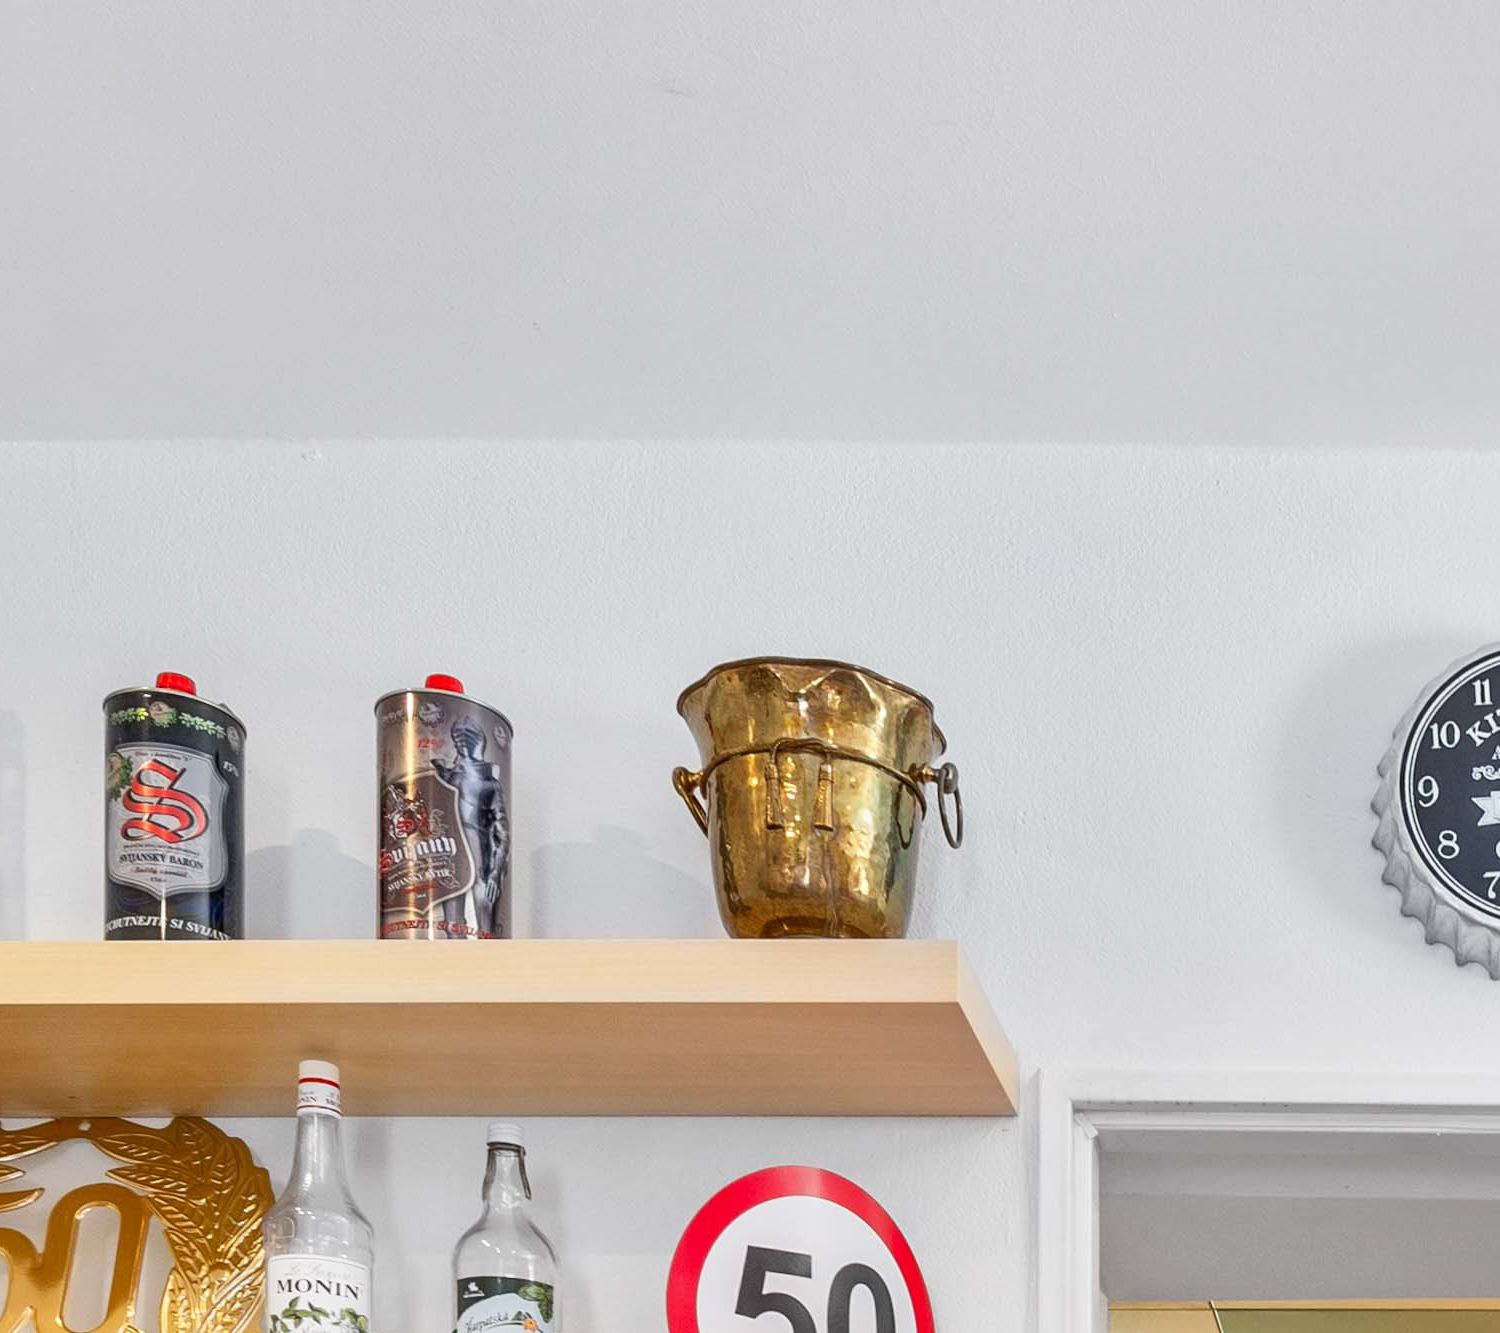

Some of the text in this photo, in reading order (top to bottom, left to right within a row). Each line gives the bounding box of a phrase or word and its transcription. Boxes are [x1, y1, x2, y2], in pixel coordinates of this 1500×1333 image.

[1472, 679, 1493, 705] 11
[1430, 720, 1460, 749] 10
[1418, 776, 1439, 807] 9
[1438, 830, 1460, 859] 8
[276, 1278, 360, 1300] MONIN
